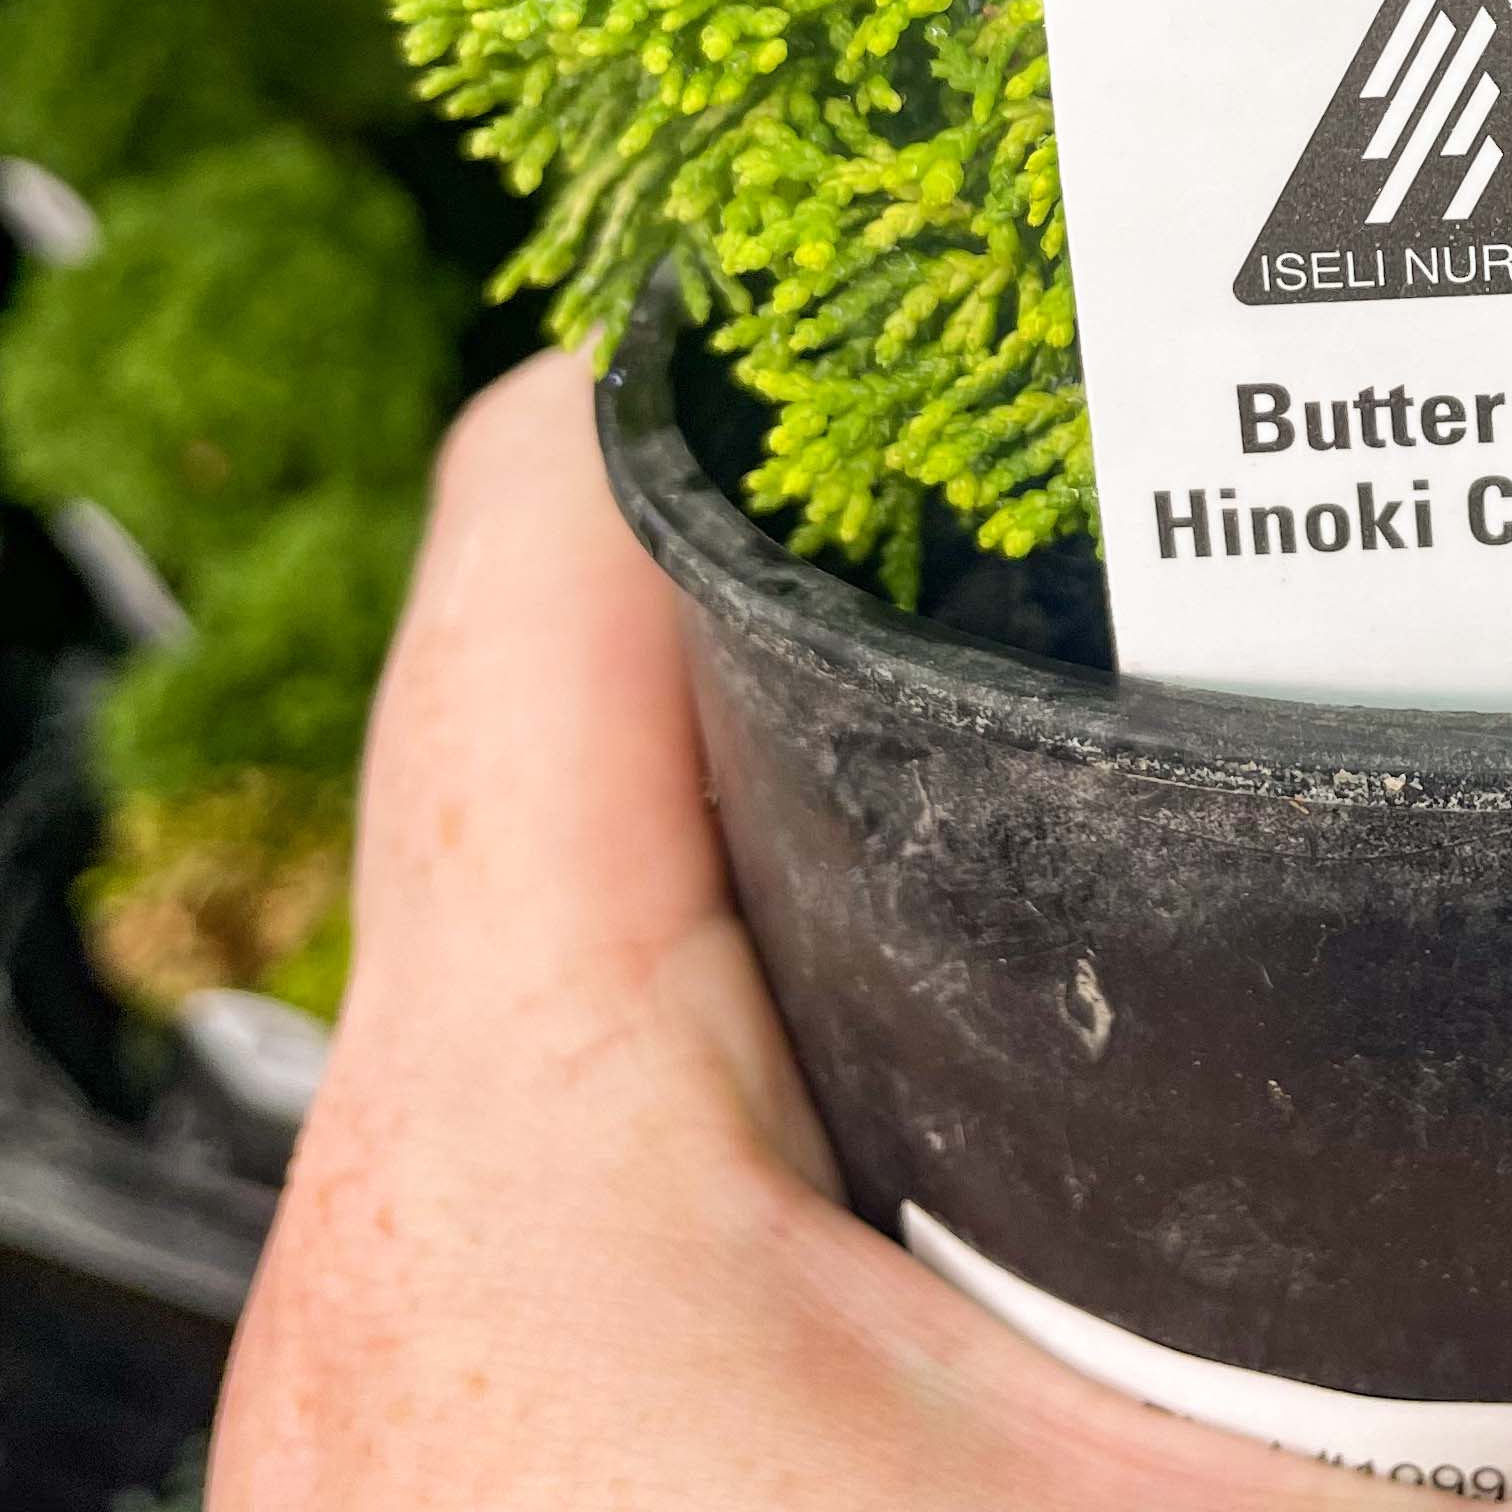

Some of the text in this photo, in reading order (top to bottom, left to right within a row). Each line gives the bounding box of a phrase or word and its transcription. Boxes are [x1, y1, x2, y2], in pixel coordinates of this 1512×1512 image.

[1260, 249, 1386, 293] ISELI
[1236, 383, 1506, 454] Butter
[1154, 479, 1433, 559] Hinoki
